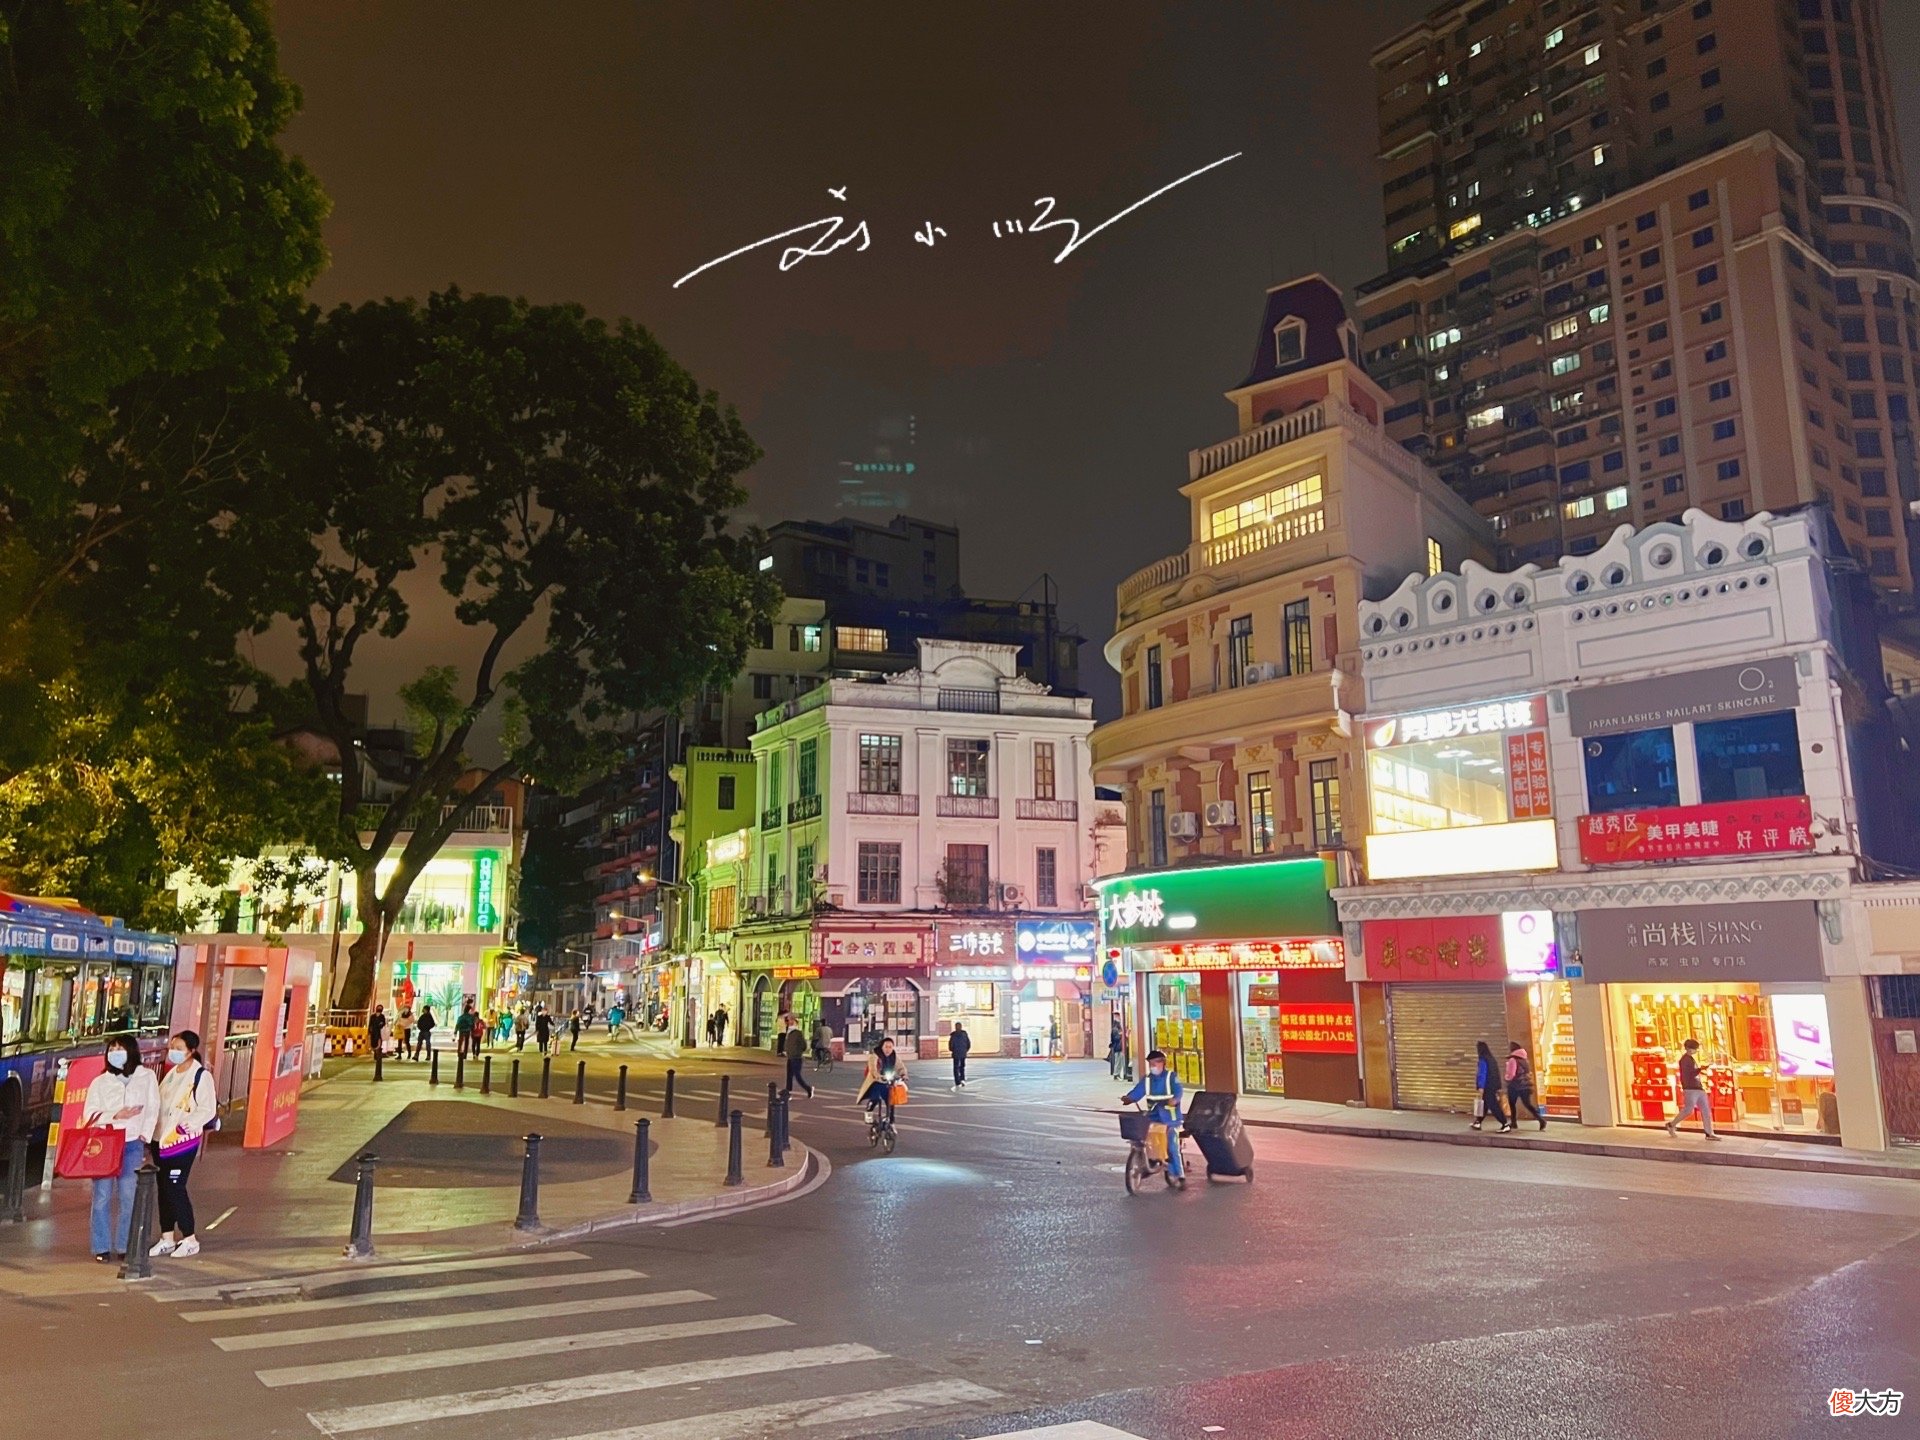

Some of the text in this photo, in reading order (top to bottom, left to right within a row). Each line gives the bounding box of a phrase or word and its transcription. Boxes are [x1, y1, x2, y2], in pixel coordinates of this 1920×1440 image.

[1589, 695, 1776, 730] JAPAN LASHES NAILART SKINCARE
[1589, 814, 1810, 850] 越秀区 美甲美睫 好评榜
[1707, 920, 1762, 932] SHANG
[1642, 922, 1697, 947] 尚栈
[1710, 933, 1751, 945] ZHAN
[1712, 956, 1746, 967] 专门店
[1281, 1014, 1353, 1026] 新冠疫苗接种点在
[1282, 1030, 1355, 1042] 东湖公园北门入口处
